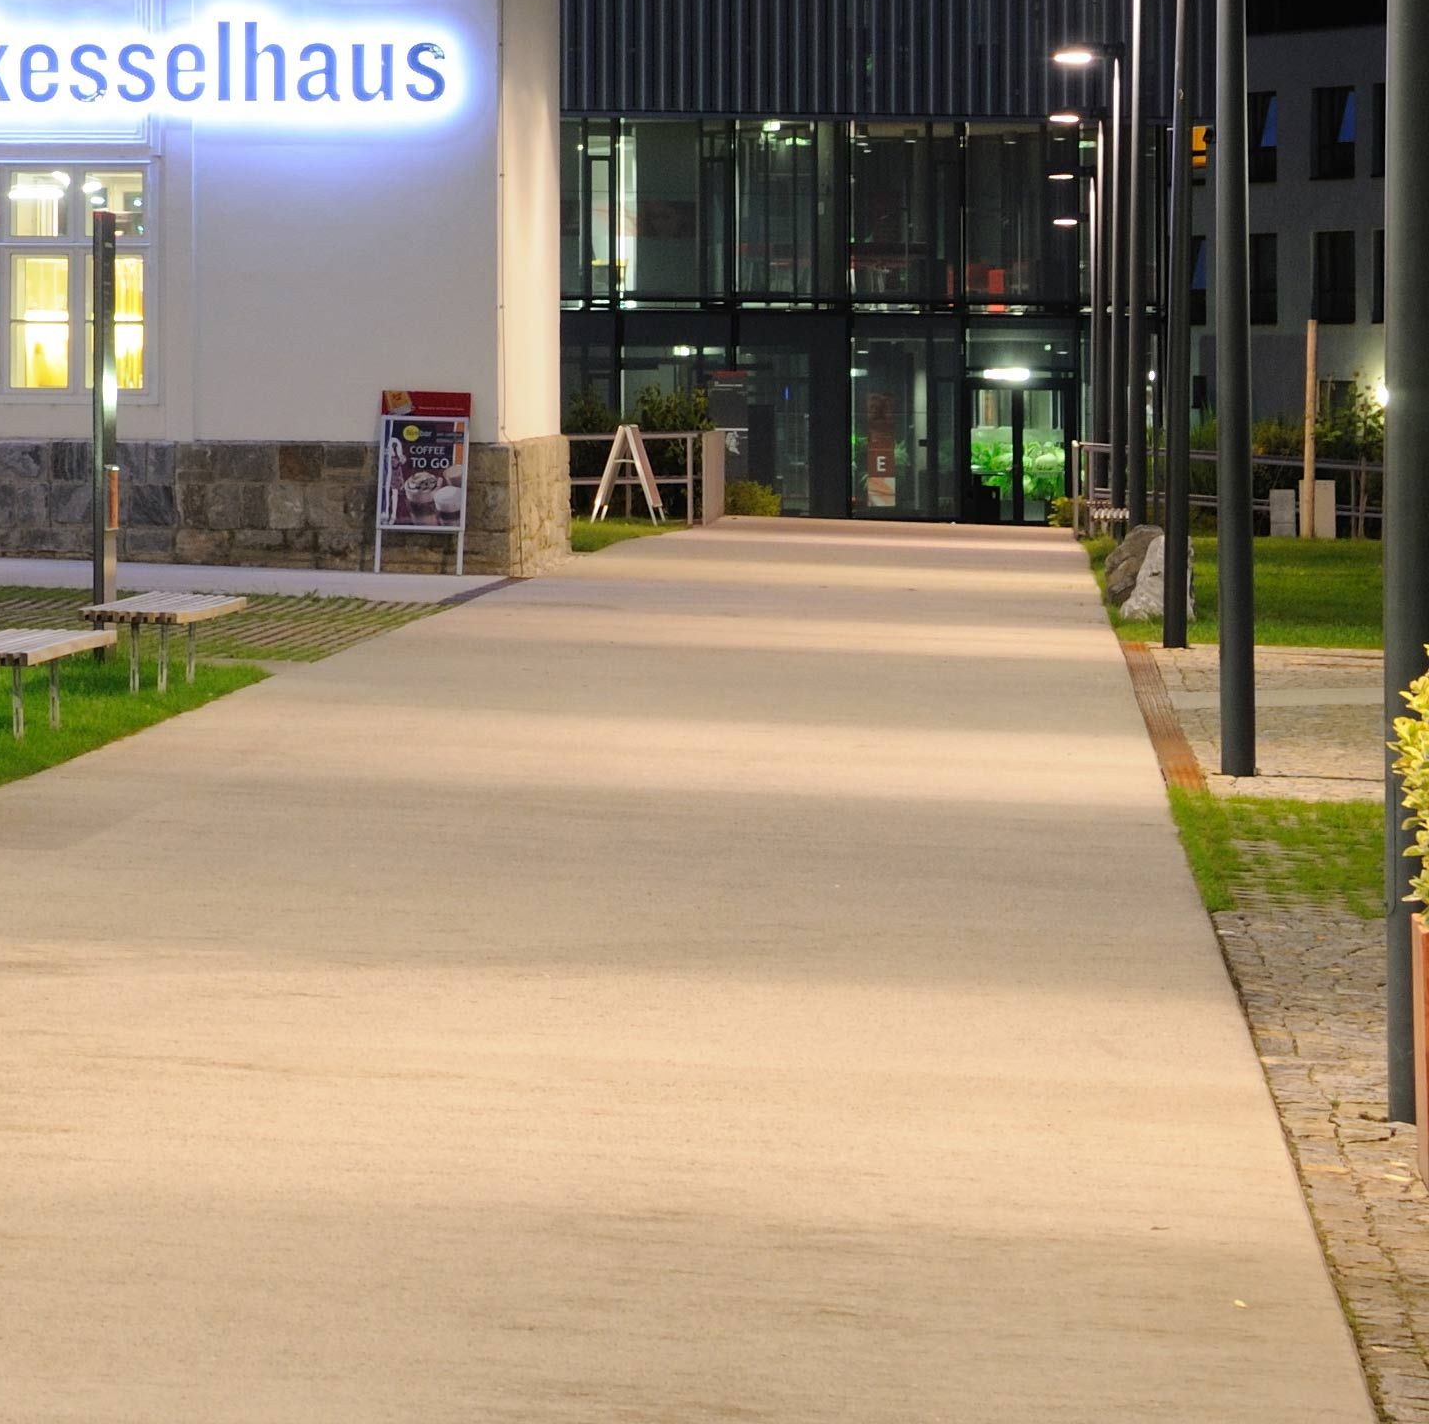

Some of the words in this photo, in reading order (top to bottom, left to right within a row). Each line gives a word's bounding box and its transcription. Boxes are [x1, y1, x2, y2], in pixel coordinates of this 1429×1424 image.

[410, 446, 445, 455] COFFEE
[411, 457, 427, 468] TO
[431, 457, 450, 469] GO
[876, 455, 887, 473] E
